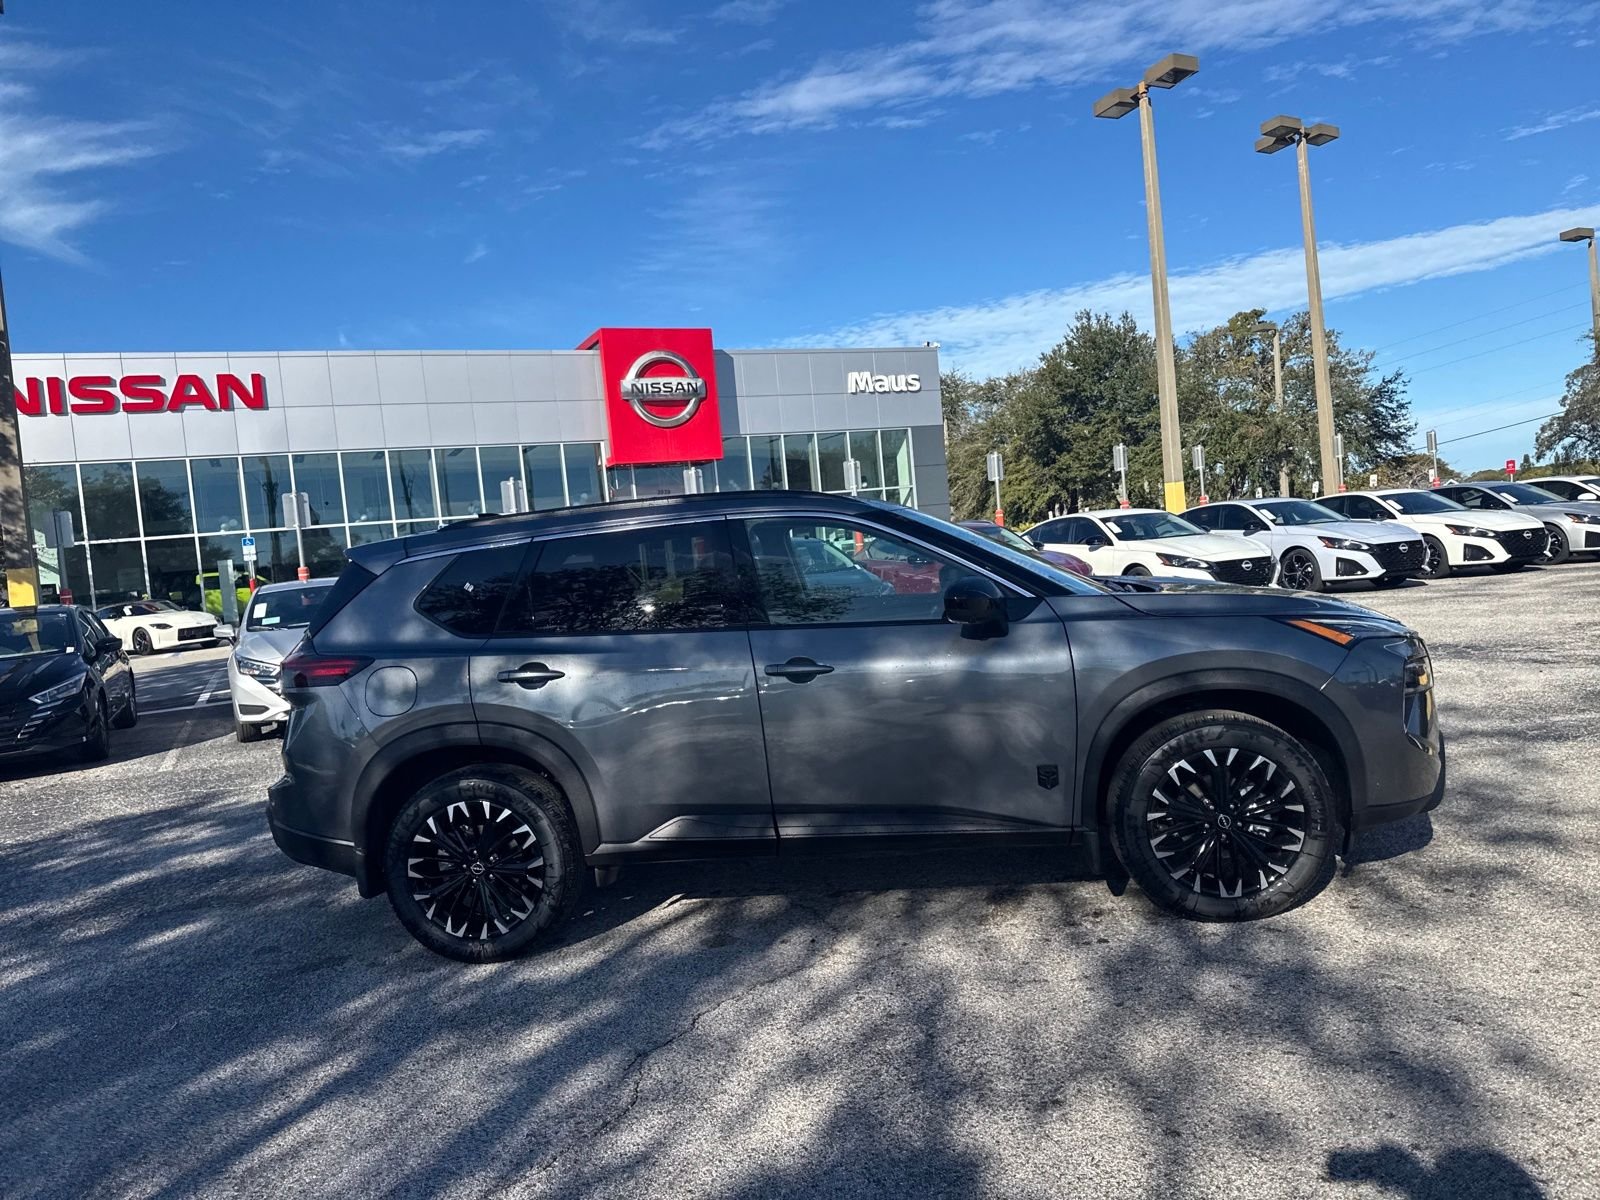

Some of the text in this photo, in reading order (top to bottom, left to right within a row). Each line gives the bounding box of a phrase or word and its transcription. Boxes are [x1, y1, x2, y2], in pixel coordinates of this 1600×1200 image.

[631, 382, 699, 394] NISSAN
[847, 371, 921, 394] Maus
[13, 373, 267, 416] NISSAN
